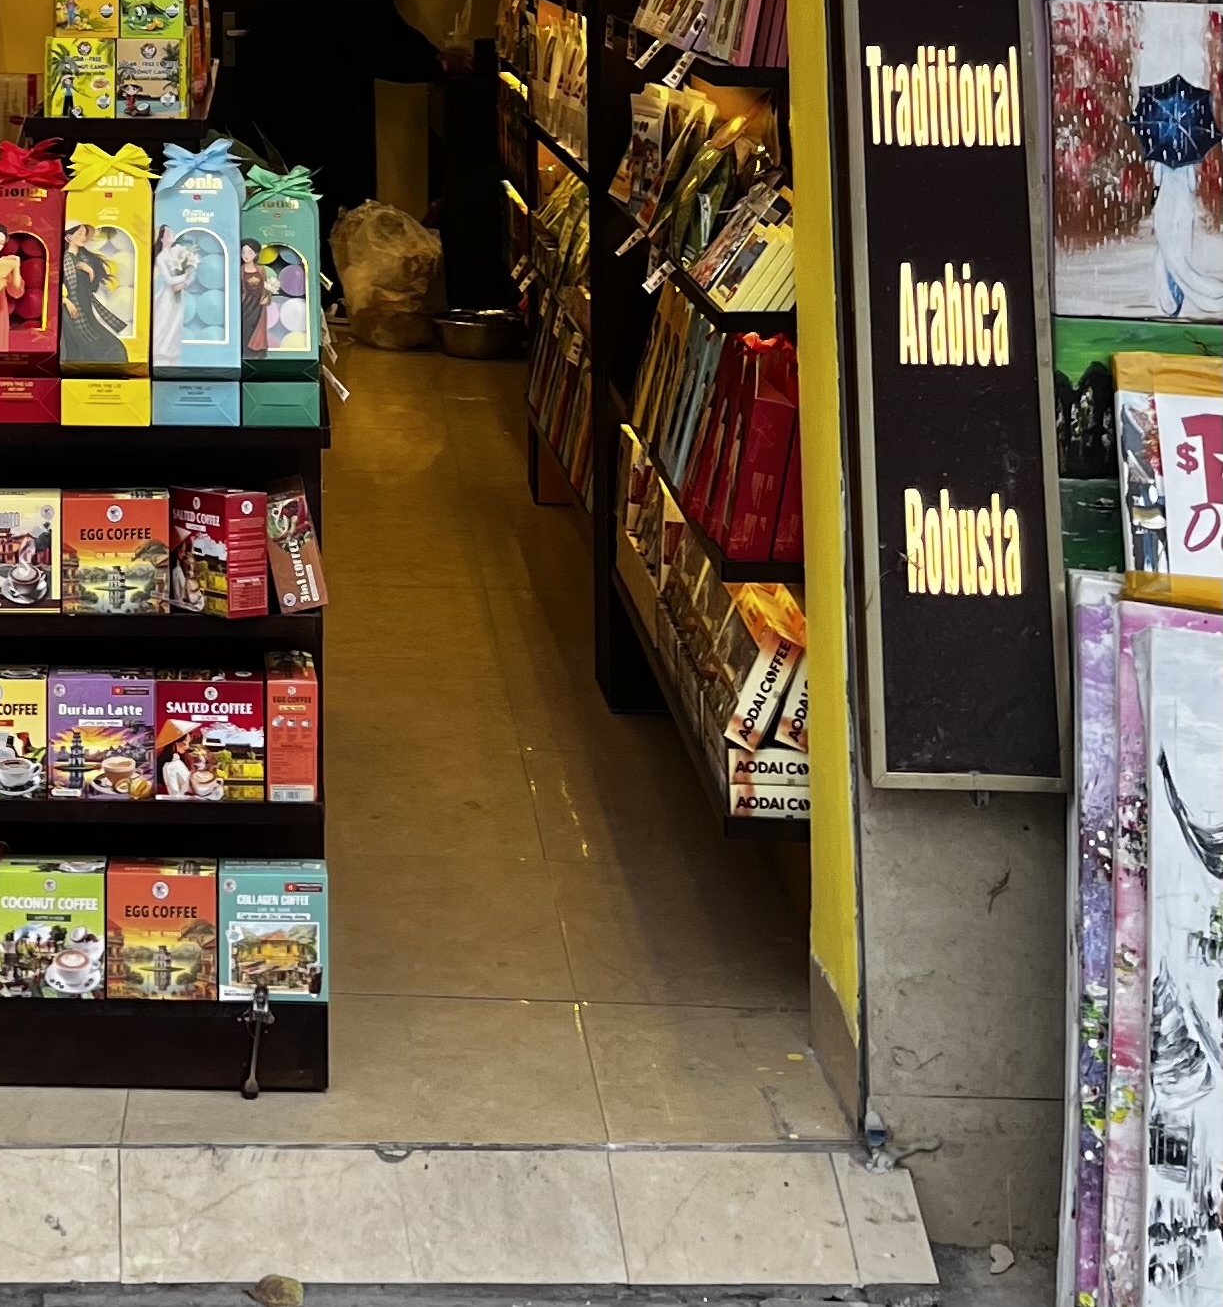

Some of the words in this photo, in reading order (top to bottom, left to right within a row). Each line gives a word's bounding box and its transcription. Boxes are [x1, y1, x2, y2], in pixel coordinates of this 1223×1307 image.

[865, 45, 1022, 147] Traditional
[898, 262, 1010, 367] Arabica
[80, 528, 104, 540] EGG
[106, 527, 151, 541] COFFEE
[904, 488, 1023, 597] Robusta
[58, 703, 104, 716] Durian
[107, 703, 144, 716] Latte
[166, 701, 209, 715] SALTED
[211, 702, 253, 715] COFFEE
[735, 760, 784, 775] AODAI
[736, 796, 785, 811] AODAI
[0, 895, 55, 910] COCONUT
[57, 896, 99, 911] COFFEE
[236, 894, 279, 906] COLLAGEN
[280, 895, 310, 906] COFFEE
[125, 905, 149, 918] EGG
[152, 905, 198, 919] COFFEE
